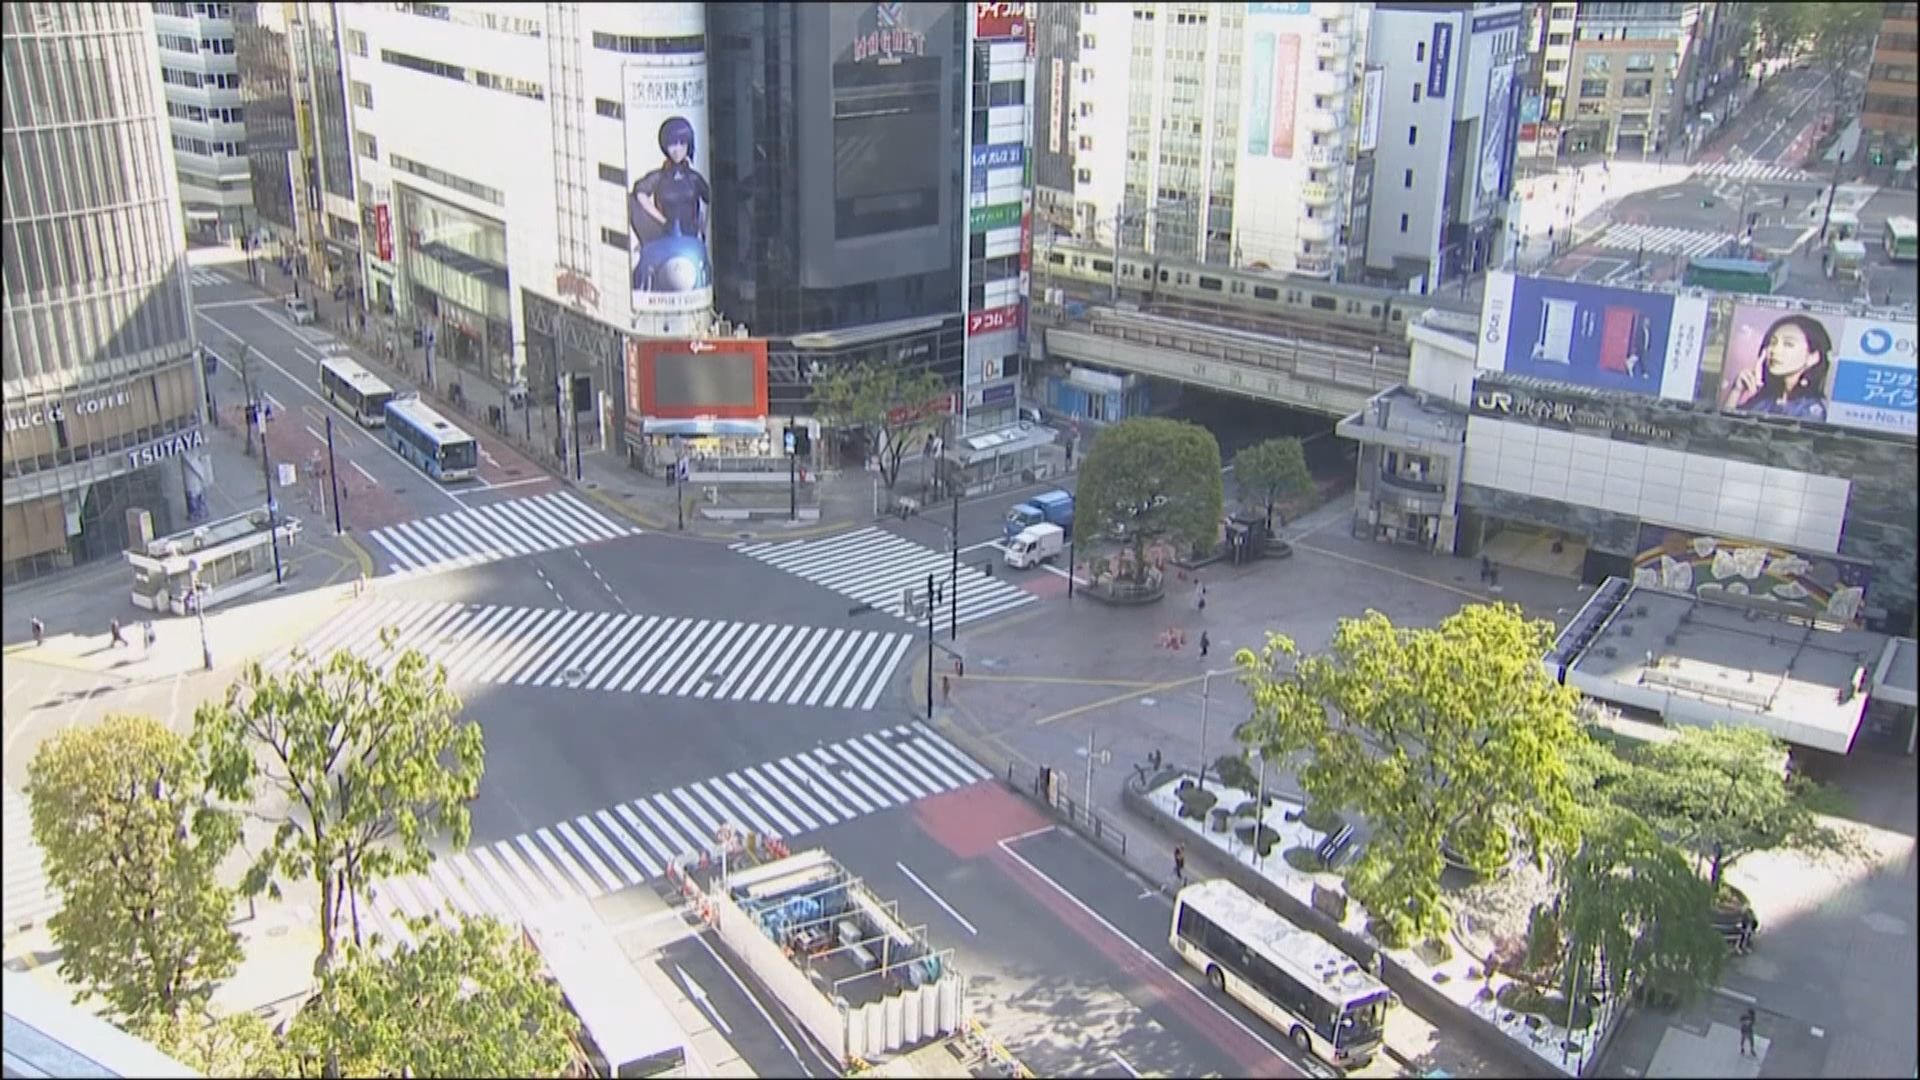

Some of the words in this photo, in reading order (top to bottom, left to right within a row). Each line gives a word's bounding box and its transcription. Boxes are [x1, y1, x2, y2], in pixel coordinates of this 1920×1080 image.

[979, 3, 1024, 18] アイフル
[970, 313, 1003, 331] アコム
[1478, 392, 1512, 413] JR
[129, 430, 204, 469] TSUTAYA
